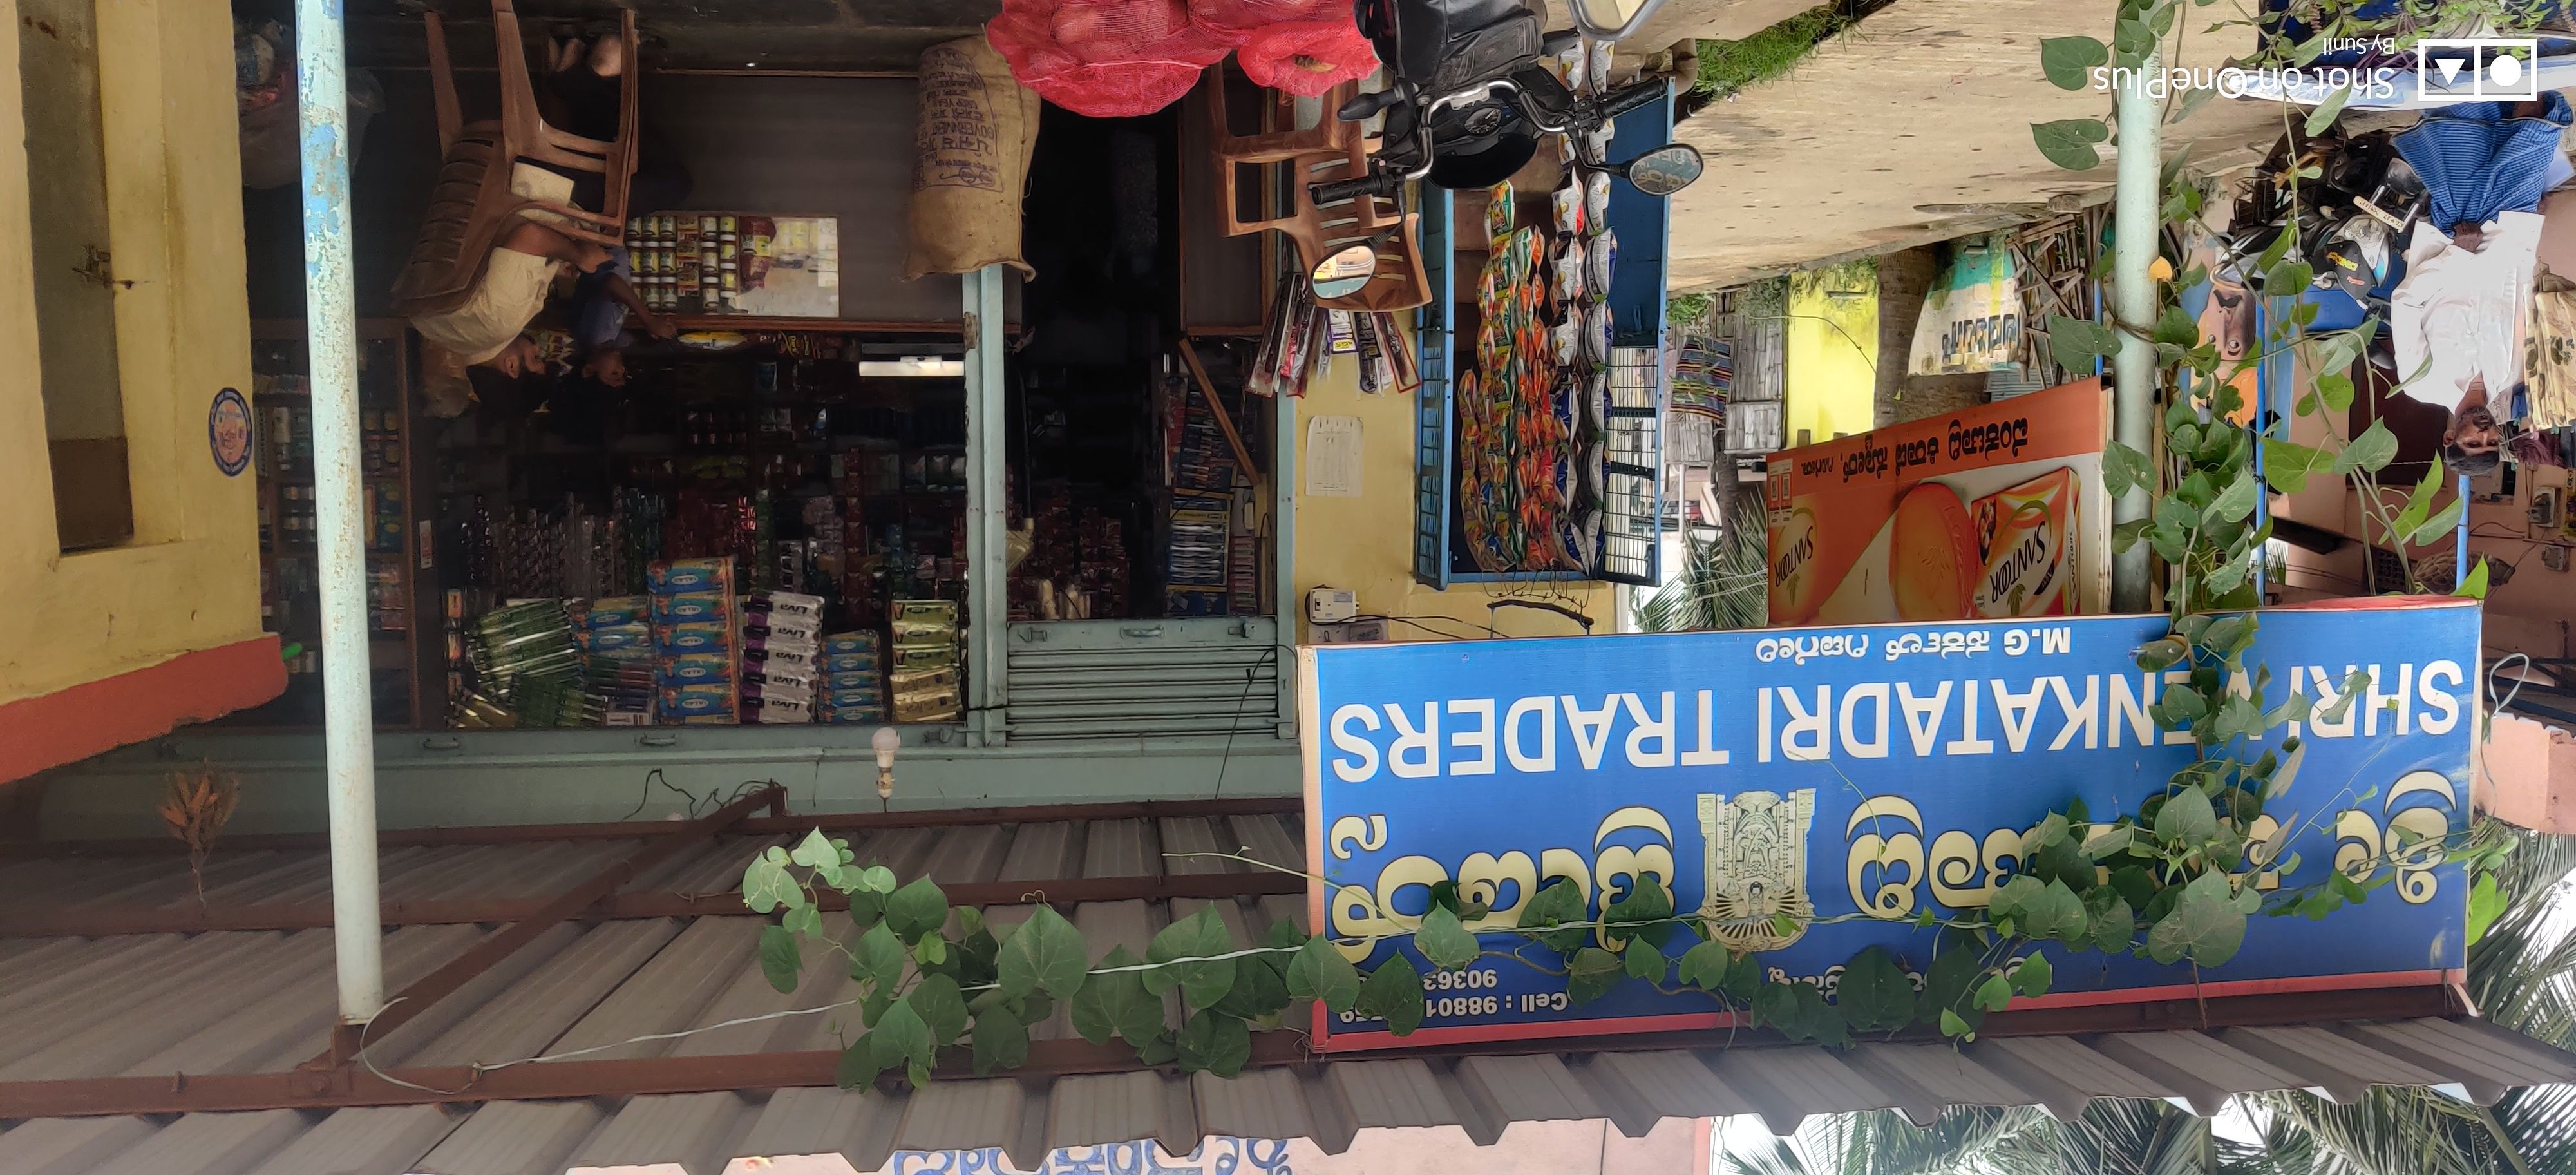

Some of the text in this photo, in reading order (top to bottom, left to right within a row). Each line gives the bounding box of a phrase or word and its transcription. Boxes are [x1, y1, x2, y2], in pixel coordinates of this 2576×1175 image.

[1774, 526, 1814, 588] SANTOOR
[1989, 520, 2045, 604] SANTOOR
[1884, 629, 1991, 662] ಸರ್ಕಲ್
[2003, 627, 2071, 656] M.G
[2289, 659, 2463, 739] SHRI
[1329, 688, 1729, 783] TRADERS
[2333, 770, 2458, 906] ಶ್ರೀ
[1520, 992, 1568, 1013] Cell
